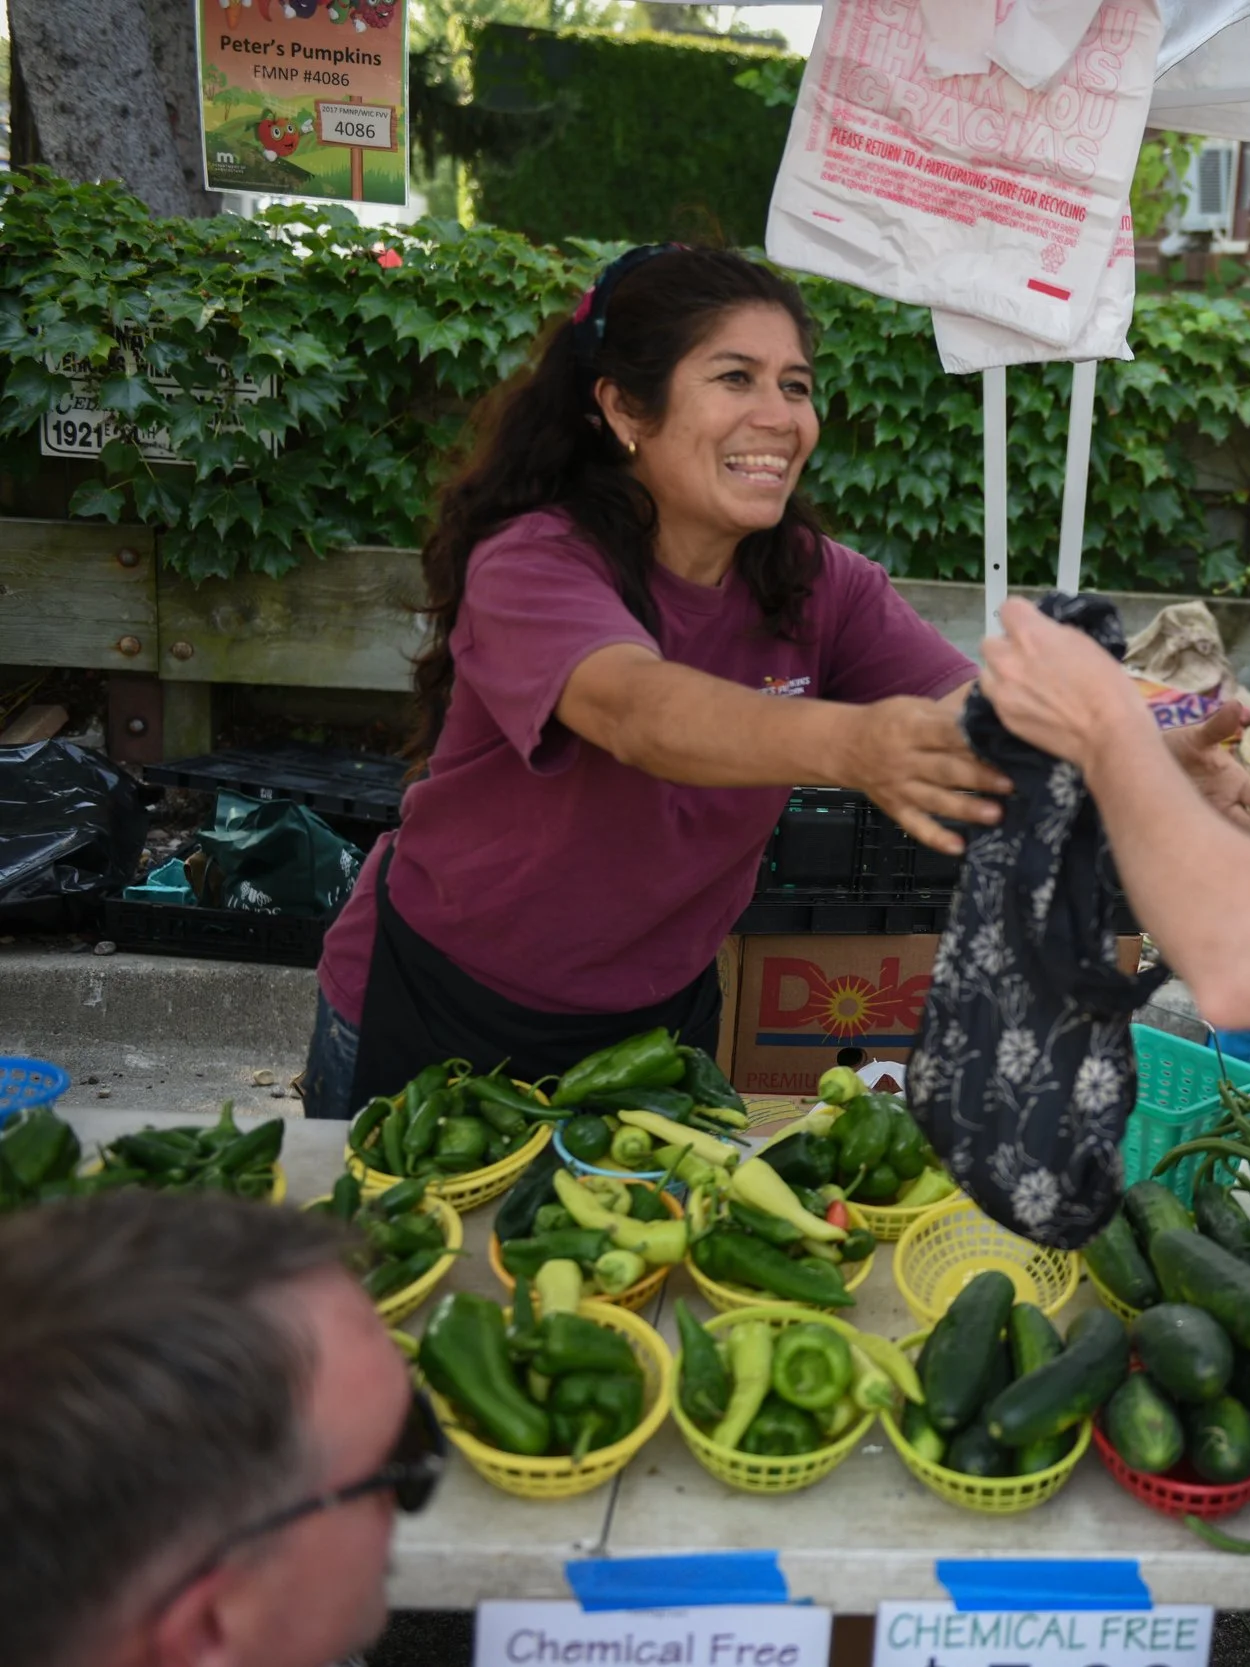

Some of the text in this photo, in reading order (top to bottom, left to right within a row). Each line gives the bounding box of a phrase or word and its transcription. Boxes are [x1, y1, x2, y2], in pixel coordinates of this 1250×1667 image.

[220, 35, 382, 66] Peter's Pumpkins
[253, 64, 350, 87] FMNP #4086
[322, 105, 338, 114] 2017
[844, 64, 1099, 181] GRACIAS
[334, 120, 376, 139] 4086
[830, 127, 865, 151] PLEASE
[864, 138, 903, 163] RETURN
[903, 148, 916, 167] TO
[915, 155, 925, 170] A
[924, 158, 988, 190] PARTICIPATING
[988, 177, 1019, 200] STORE
[1018, 187, 1038, 207] FOR
[1038, 194, 1087, 223] RECYCLING
[53, 420, 103, 449] 1921
[758, 957, 933, 1038] Dole
[746, 1072, 819, 1090] PREMIU
[505, 1627, 799, 1666] Chemical Free
[887, 1611, 1199, 1651] CHEMICAL FREE
